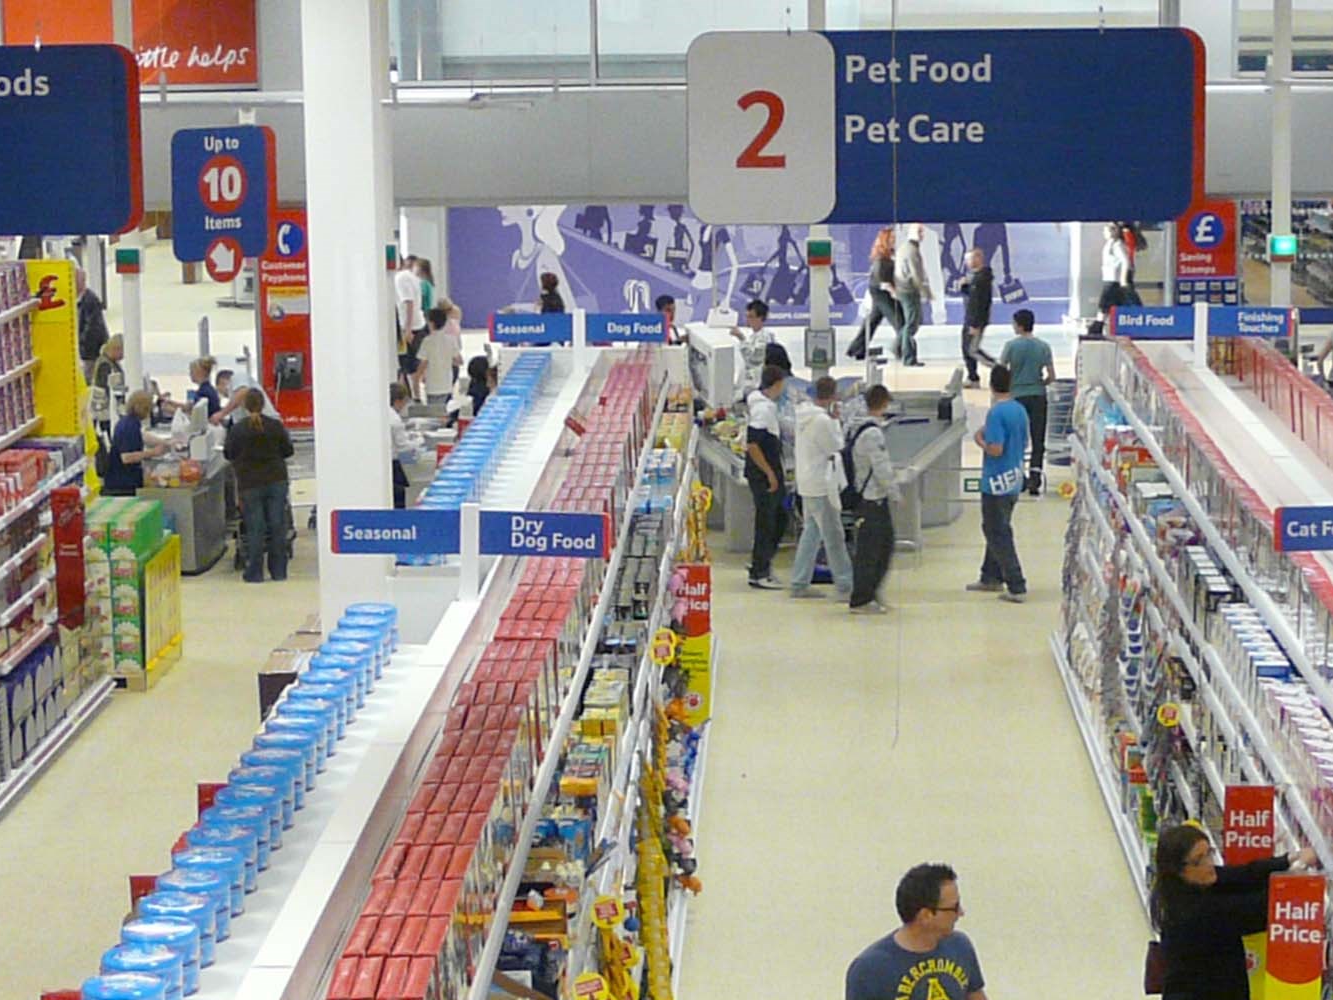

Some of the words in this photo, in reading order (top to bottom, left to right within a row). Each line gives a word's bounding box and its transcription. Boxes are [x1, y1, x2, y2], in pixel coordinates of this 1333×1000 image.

[136, 46, 180, 68] ittle
[187, 44, 249, 73] helps
[845, 55, 901, 84] Pet
[909, 54, 992, 84] Food
[736, 90, 786, 168] 2
[845, 115, 900, 143] Pet
[907, 115, 985, 143] Care
[204, 136, 223, 153] Up
[225, 137, 239, 150] to
[204, 166, 242, 202] 10
[204, 215, 242, 231] Items
[1118, 314, 1143, 328] Bird
[1145, 314, 1175, 328] Food
[1237, 312, 1285, 326] Finishing
[1238, 322, 1280, 334] Touches
[496, 322, 545, 336] Seasonal
[607, 322, 630, 337] Dog
[633, 322, 662, 336] Food
[342, 524, 416, 543] Seasonal
[510, 516, 544, 538] Dry
[1286, 521, 1316, 538] Cat
[510, 533, 547, 555] Dog
[552, 534, 595, 553] Food
[1230, 811, 1270, 828] Half
[1225, 831, 1271, 848] Price
[1275, 901, 1320, 921] Half
[1270, 923, 1322, 944] Price
